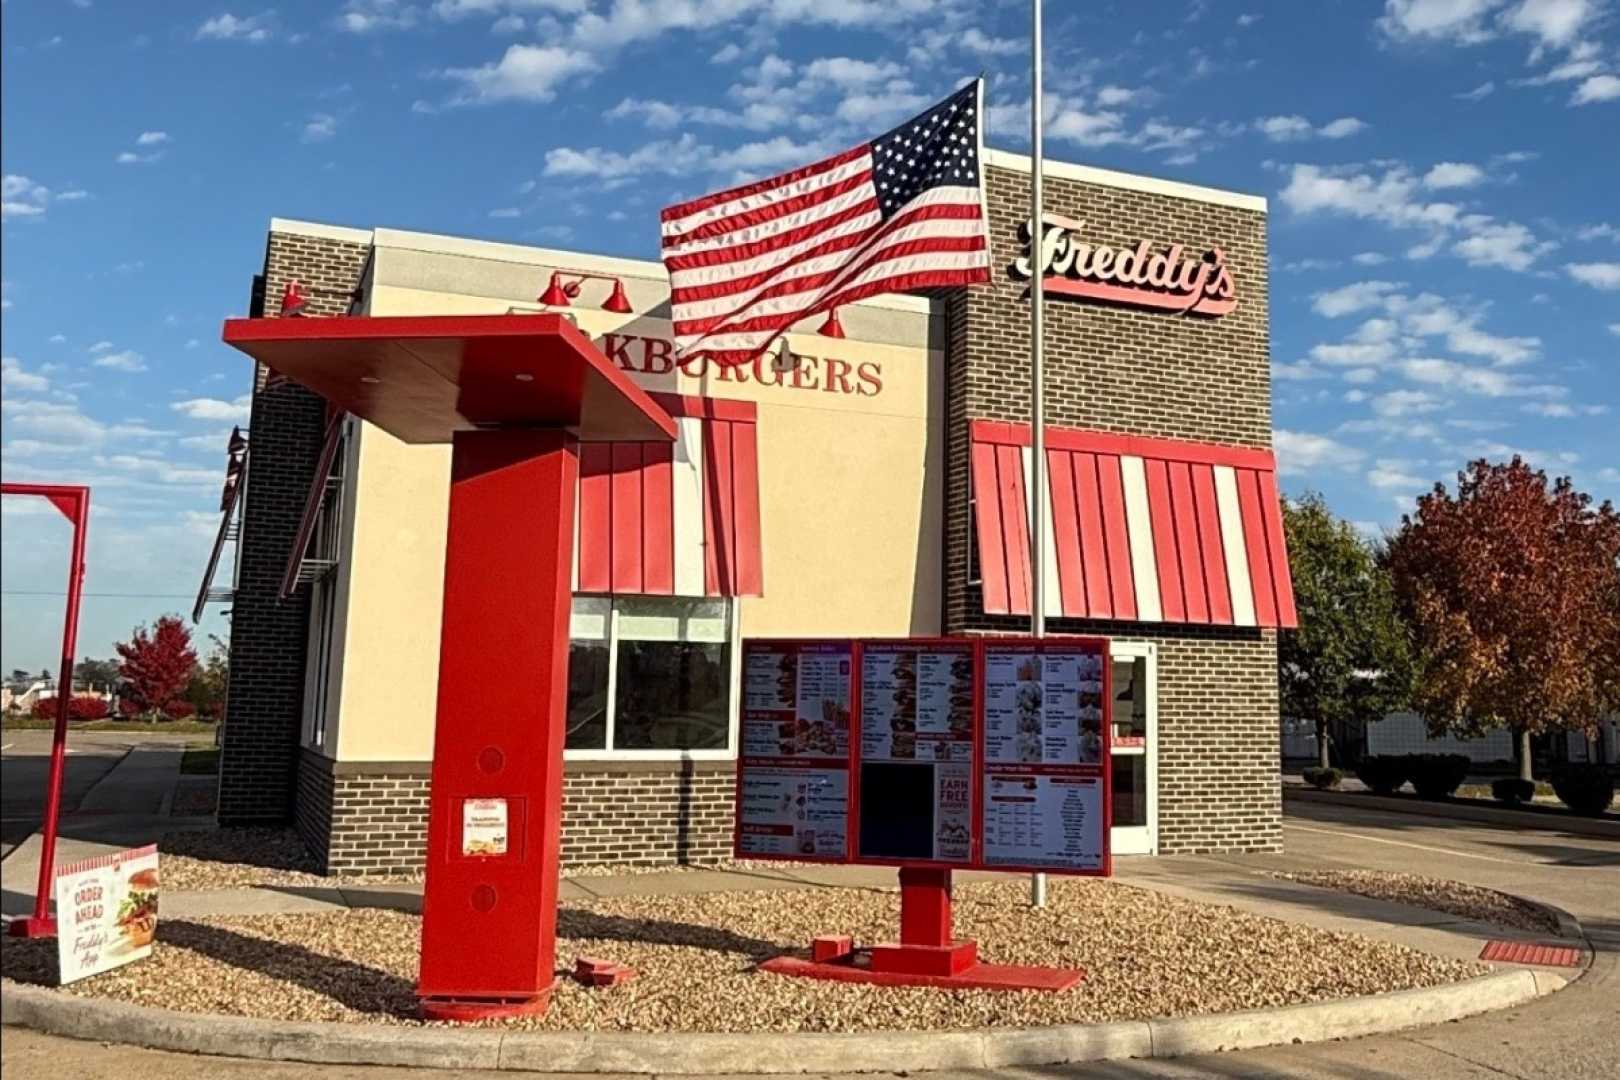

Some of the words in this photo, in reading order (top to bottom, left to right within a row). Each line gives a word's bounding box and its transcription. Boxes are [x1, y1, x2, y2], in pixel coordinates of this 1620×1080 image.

[1016, 212, 1238, 315] Freddy's
[578, 329, 883, 397] KBUGERS
[940, 790, 969, 801] FREE
[74, 886, 103, 906] ORDER
[75, 904, 104, 924] AHEAD
